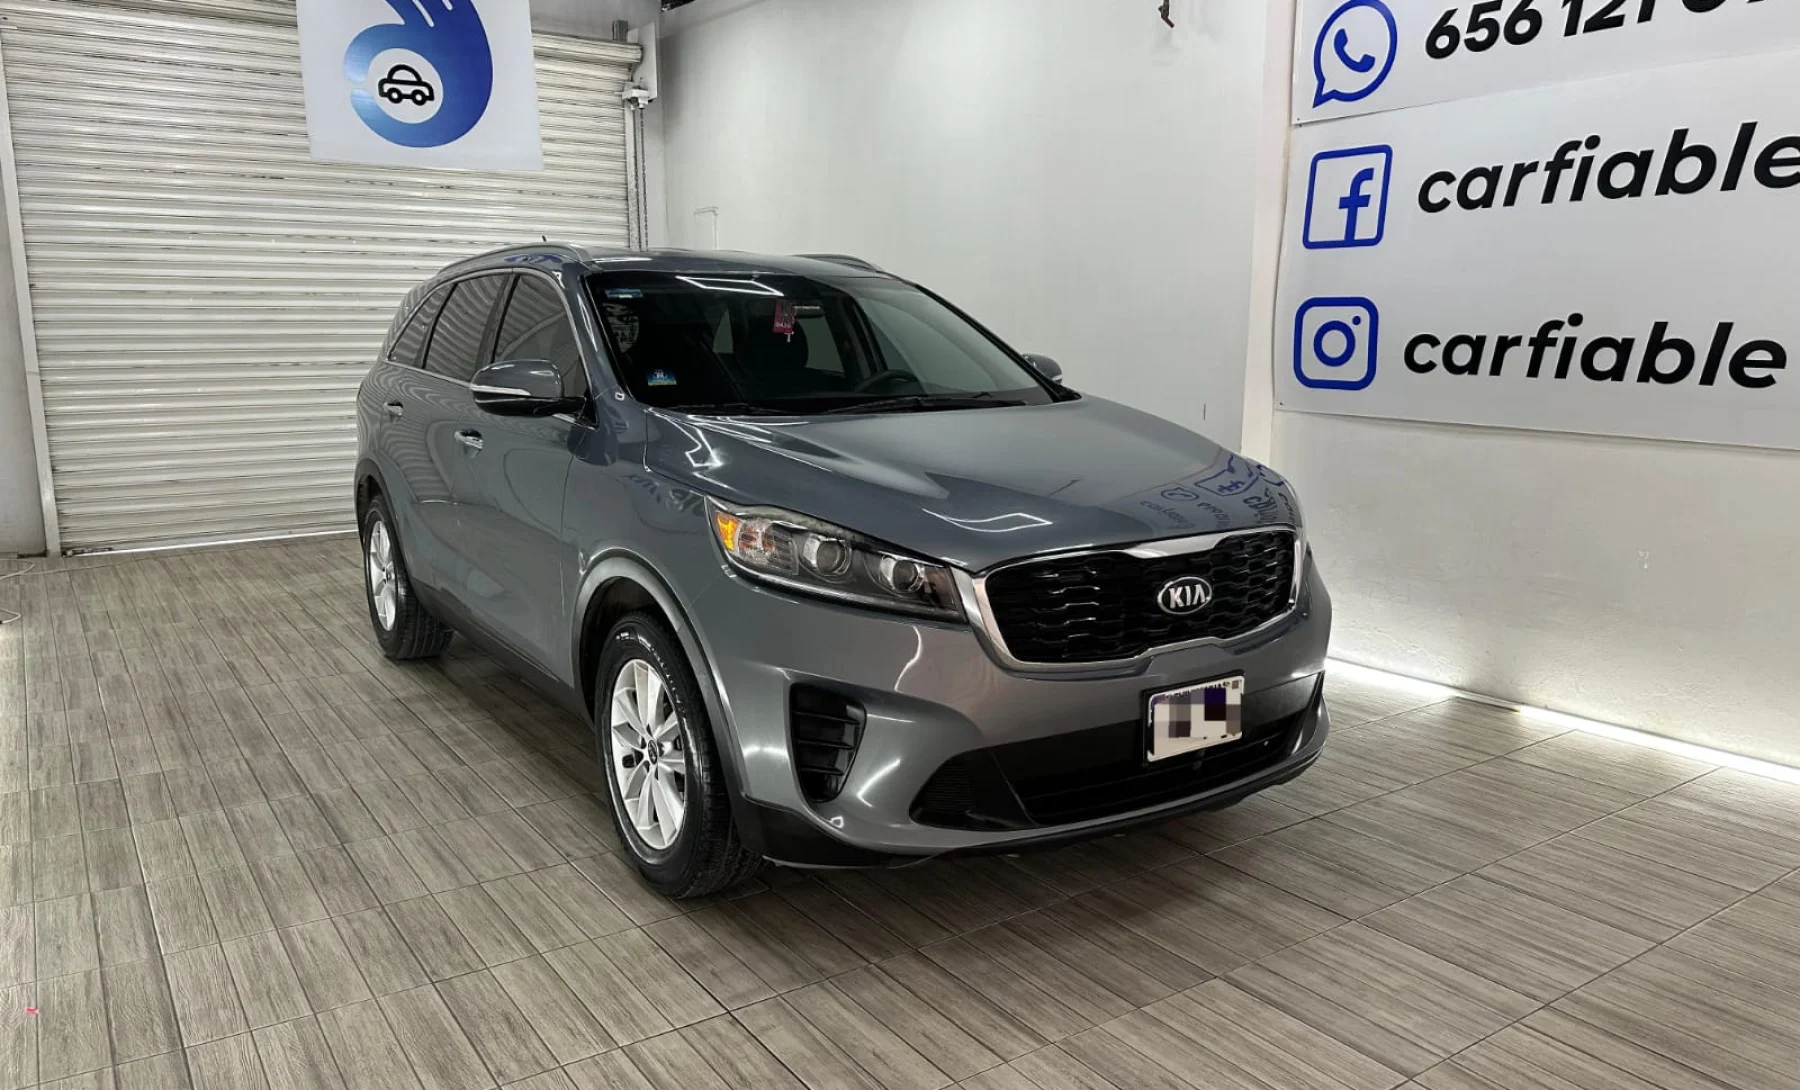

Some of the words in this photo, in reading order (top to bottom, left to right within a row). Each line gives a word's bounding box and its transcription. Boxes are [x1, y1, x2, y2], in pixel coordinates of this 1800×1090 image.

[1425, 0, 1542, 60] 656
[1418, 121, 1800, 213] carfiable
[1404, 312, 1787, 388] carfiable
[1169, 584, 1206, 609] KIA
